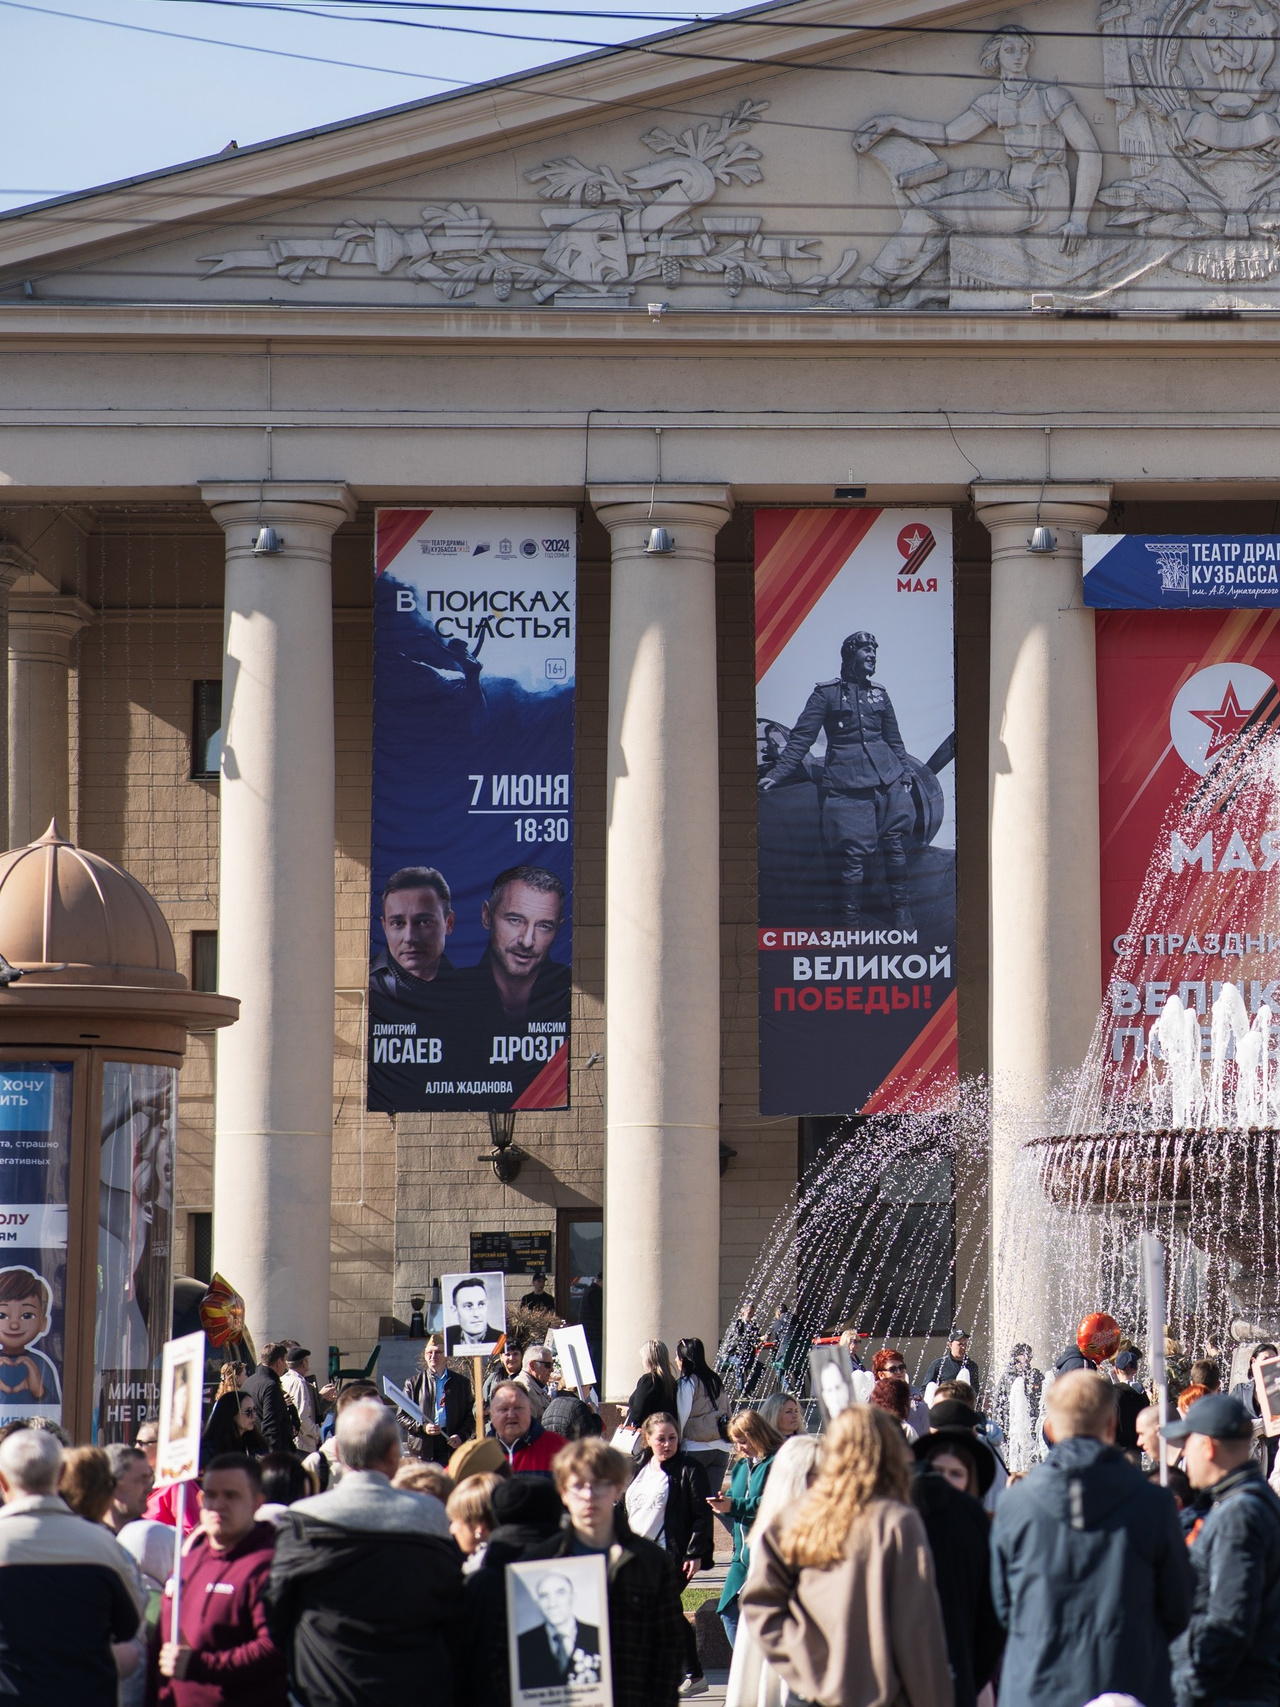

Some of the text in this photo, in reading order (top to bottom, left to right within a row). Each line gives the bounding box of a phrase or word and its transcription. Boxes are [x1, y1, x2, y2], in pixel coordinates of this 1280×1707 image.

[545, 539, 570, 552] 2024
[1192, 543, 1241, 562] ТЕАТР
[1192, 564, 1278, 584] КУЗБАССА
[897, 578, 938, 592] МАЯ
[396, 590, 571, 612] В ПОИСКАХ
[435, 617, 570, 639] СЧАСТЬЯ
[547, 663, 564, 674] 16+
[468, 774, 569, 806] 7 ИЮНЯ
[514, 818, 569, 842] 18:30
[762, 929, 918, 948] С ПРАЗДНИКОМ
[1113, 934, 1134, 956] С
[793, 945, 951, 981] ВЕЛИКОЙ
[774, 985, 933, 1015] ПОБЕДЫ!
[372, 1022, 417, 1036] ДМИТРИЙ
[528, 1022, 566, 1033] МАКСИМ
[373, 1038, 443, 1064] ИСАЕВ
[3, 1080, 45, 1092] ХОЧУ
[425, 1081, 513, 1095] АЛЛА ЖАДАНОВА
[15, 1141, 59, 1151] страшно
